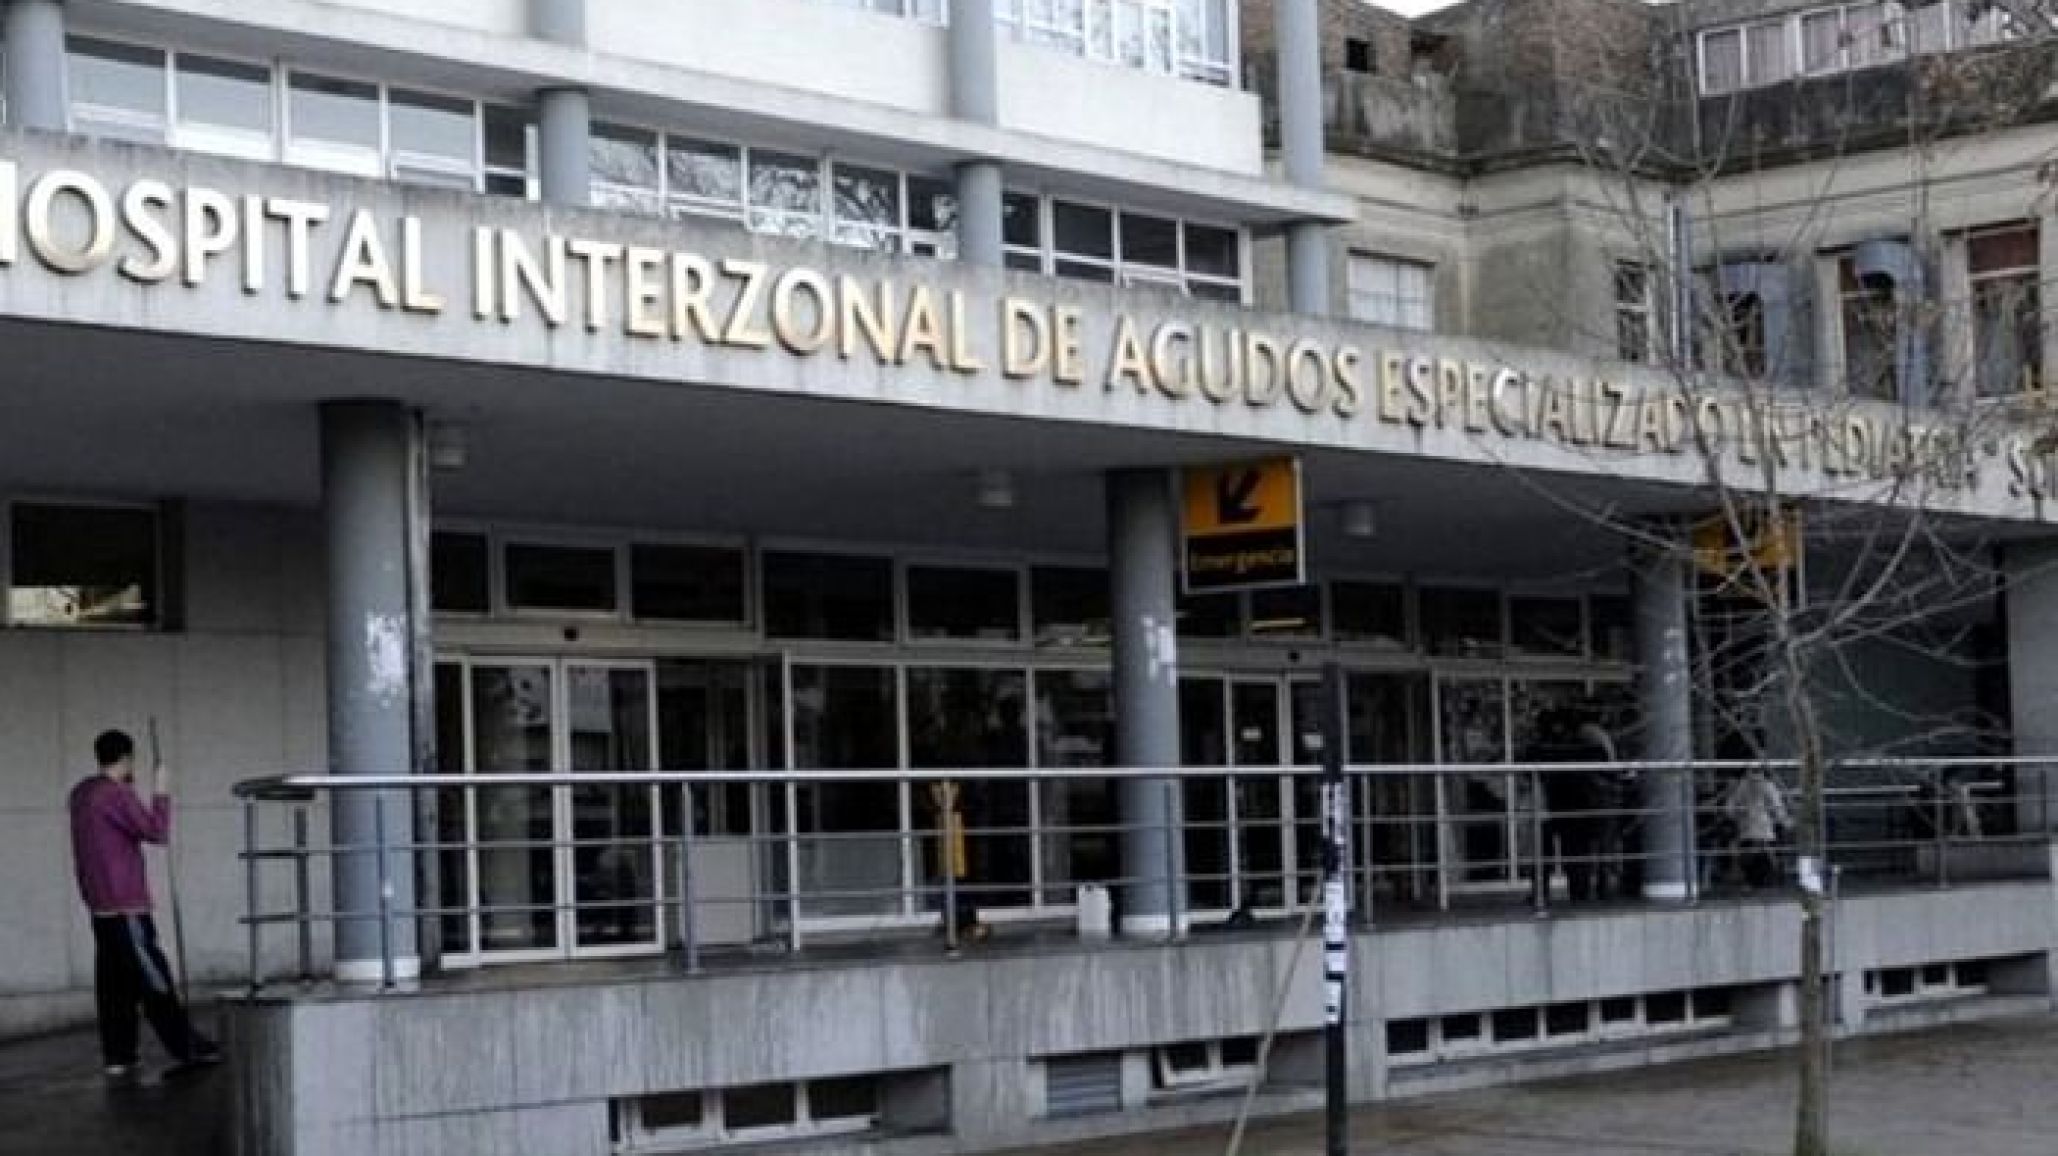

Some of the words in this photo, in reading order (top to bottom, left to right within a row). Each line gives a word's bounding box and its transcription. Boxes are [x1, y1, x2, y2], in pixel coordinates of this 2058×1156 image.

[0, 160, 447, 314] OSPITAL
[472, 225, 988, 374] INTERZONAL
[1001, 296, 1083, 385] DE
[1104, 313, 1363, 418] AGUDOS
